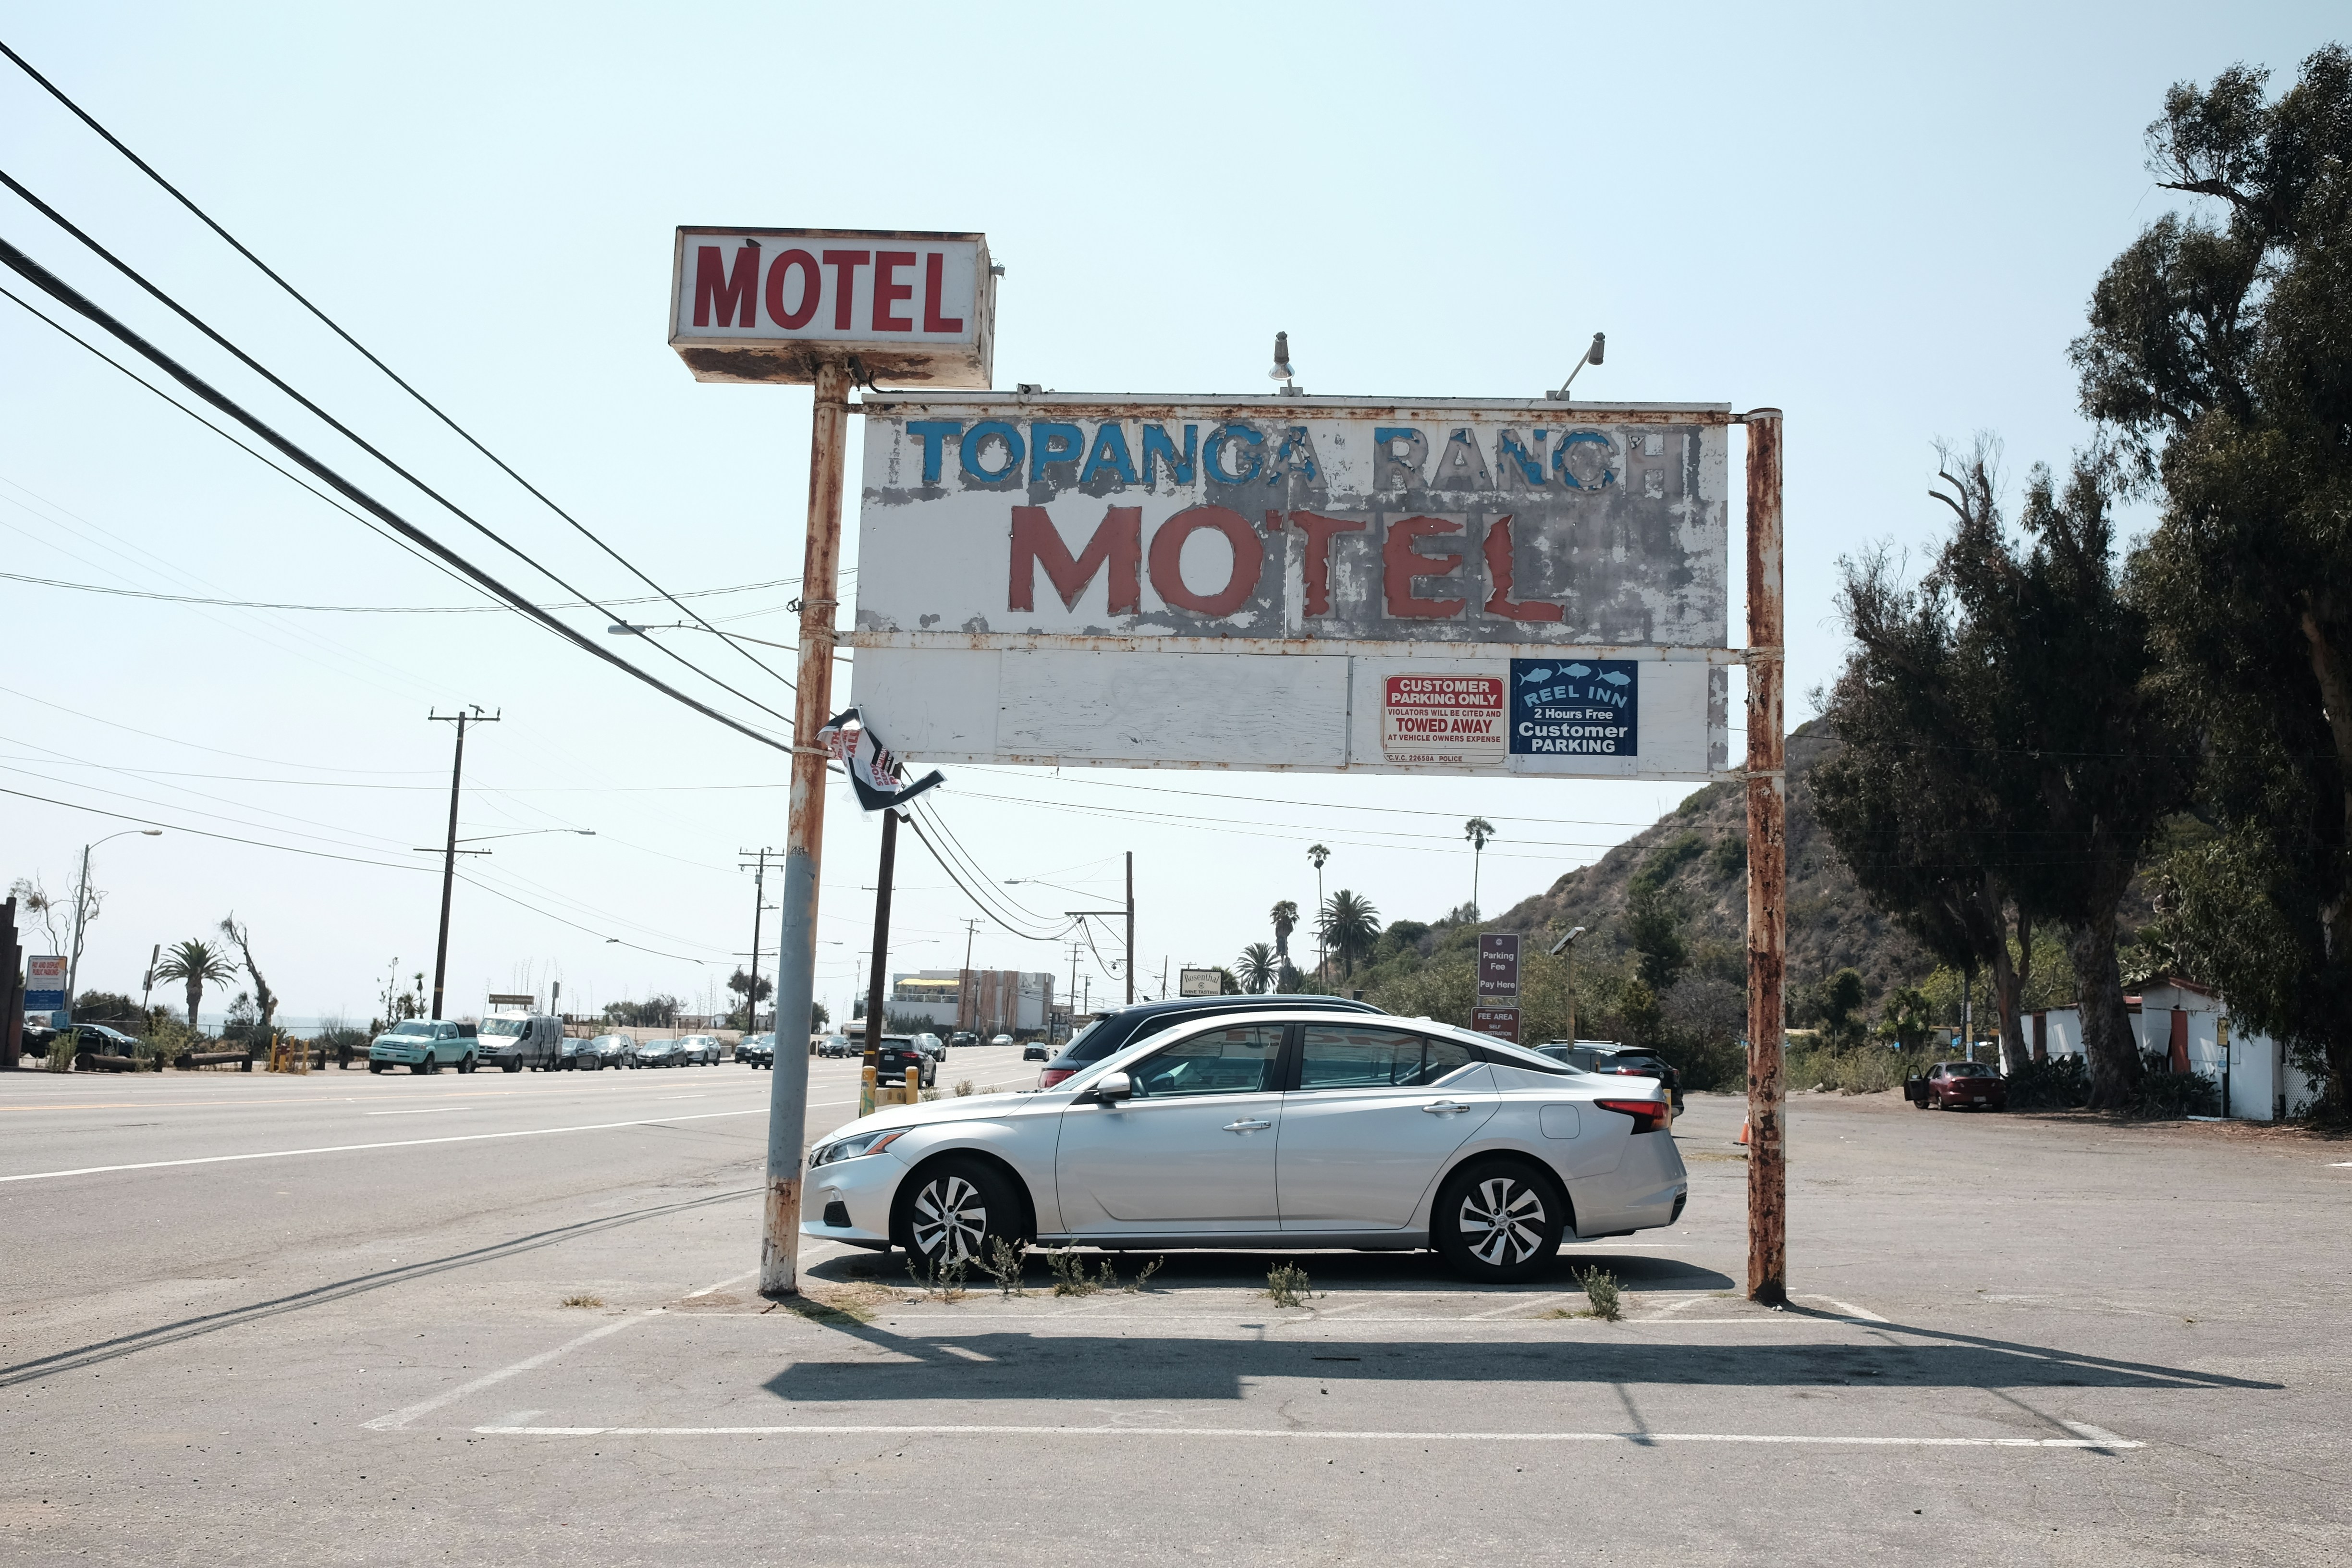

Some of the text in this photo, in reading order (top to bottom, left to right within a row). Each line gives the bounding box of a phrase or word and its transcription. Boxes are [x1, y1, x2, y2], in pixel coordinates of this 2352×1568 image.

[693, 246, 963, 332] MOTEL
[906, 421, 1685, 495] TOPANGA RANCH
[1008, 504, 1566, 622] MOTEL
[1400, 680, 1489, 692] CUSTOMER
[1391, 693, 1497, 705] PARKING ONLY
[1523, 685, 1628, 709] REEL INN
[1534, 709, 1613, 719] 2 Hours Free
[1396, 718, 1493, 734] TOWED AWAY
[1519, 722, 1628, 737] Customer
[1531, 739, 1615, 753] PARKING
[1483, 952, 1514, 961] Parking
[1184, 973, 1220, 983] Rosenthal
[1480, 980, 1494, 989] Pay
